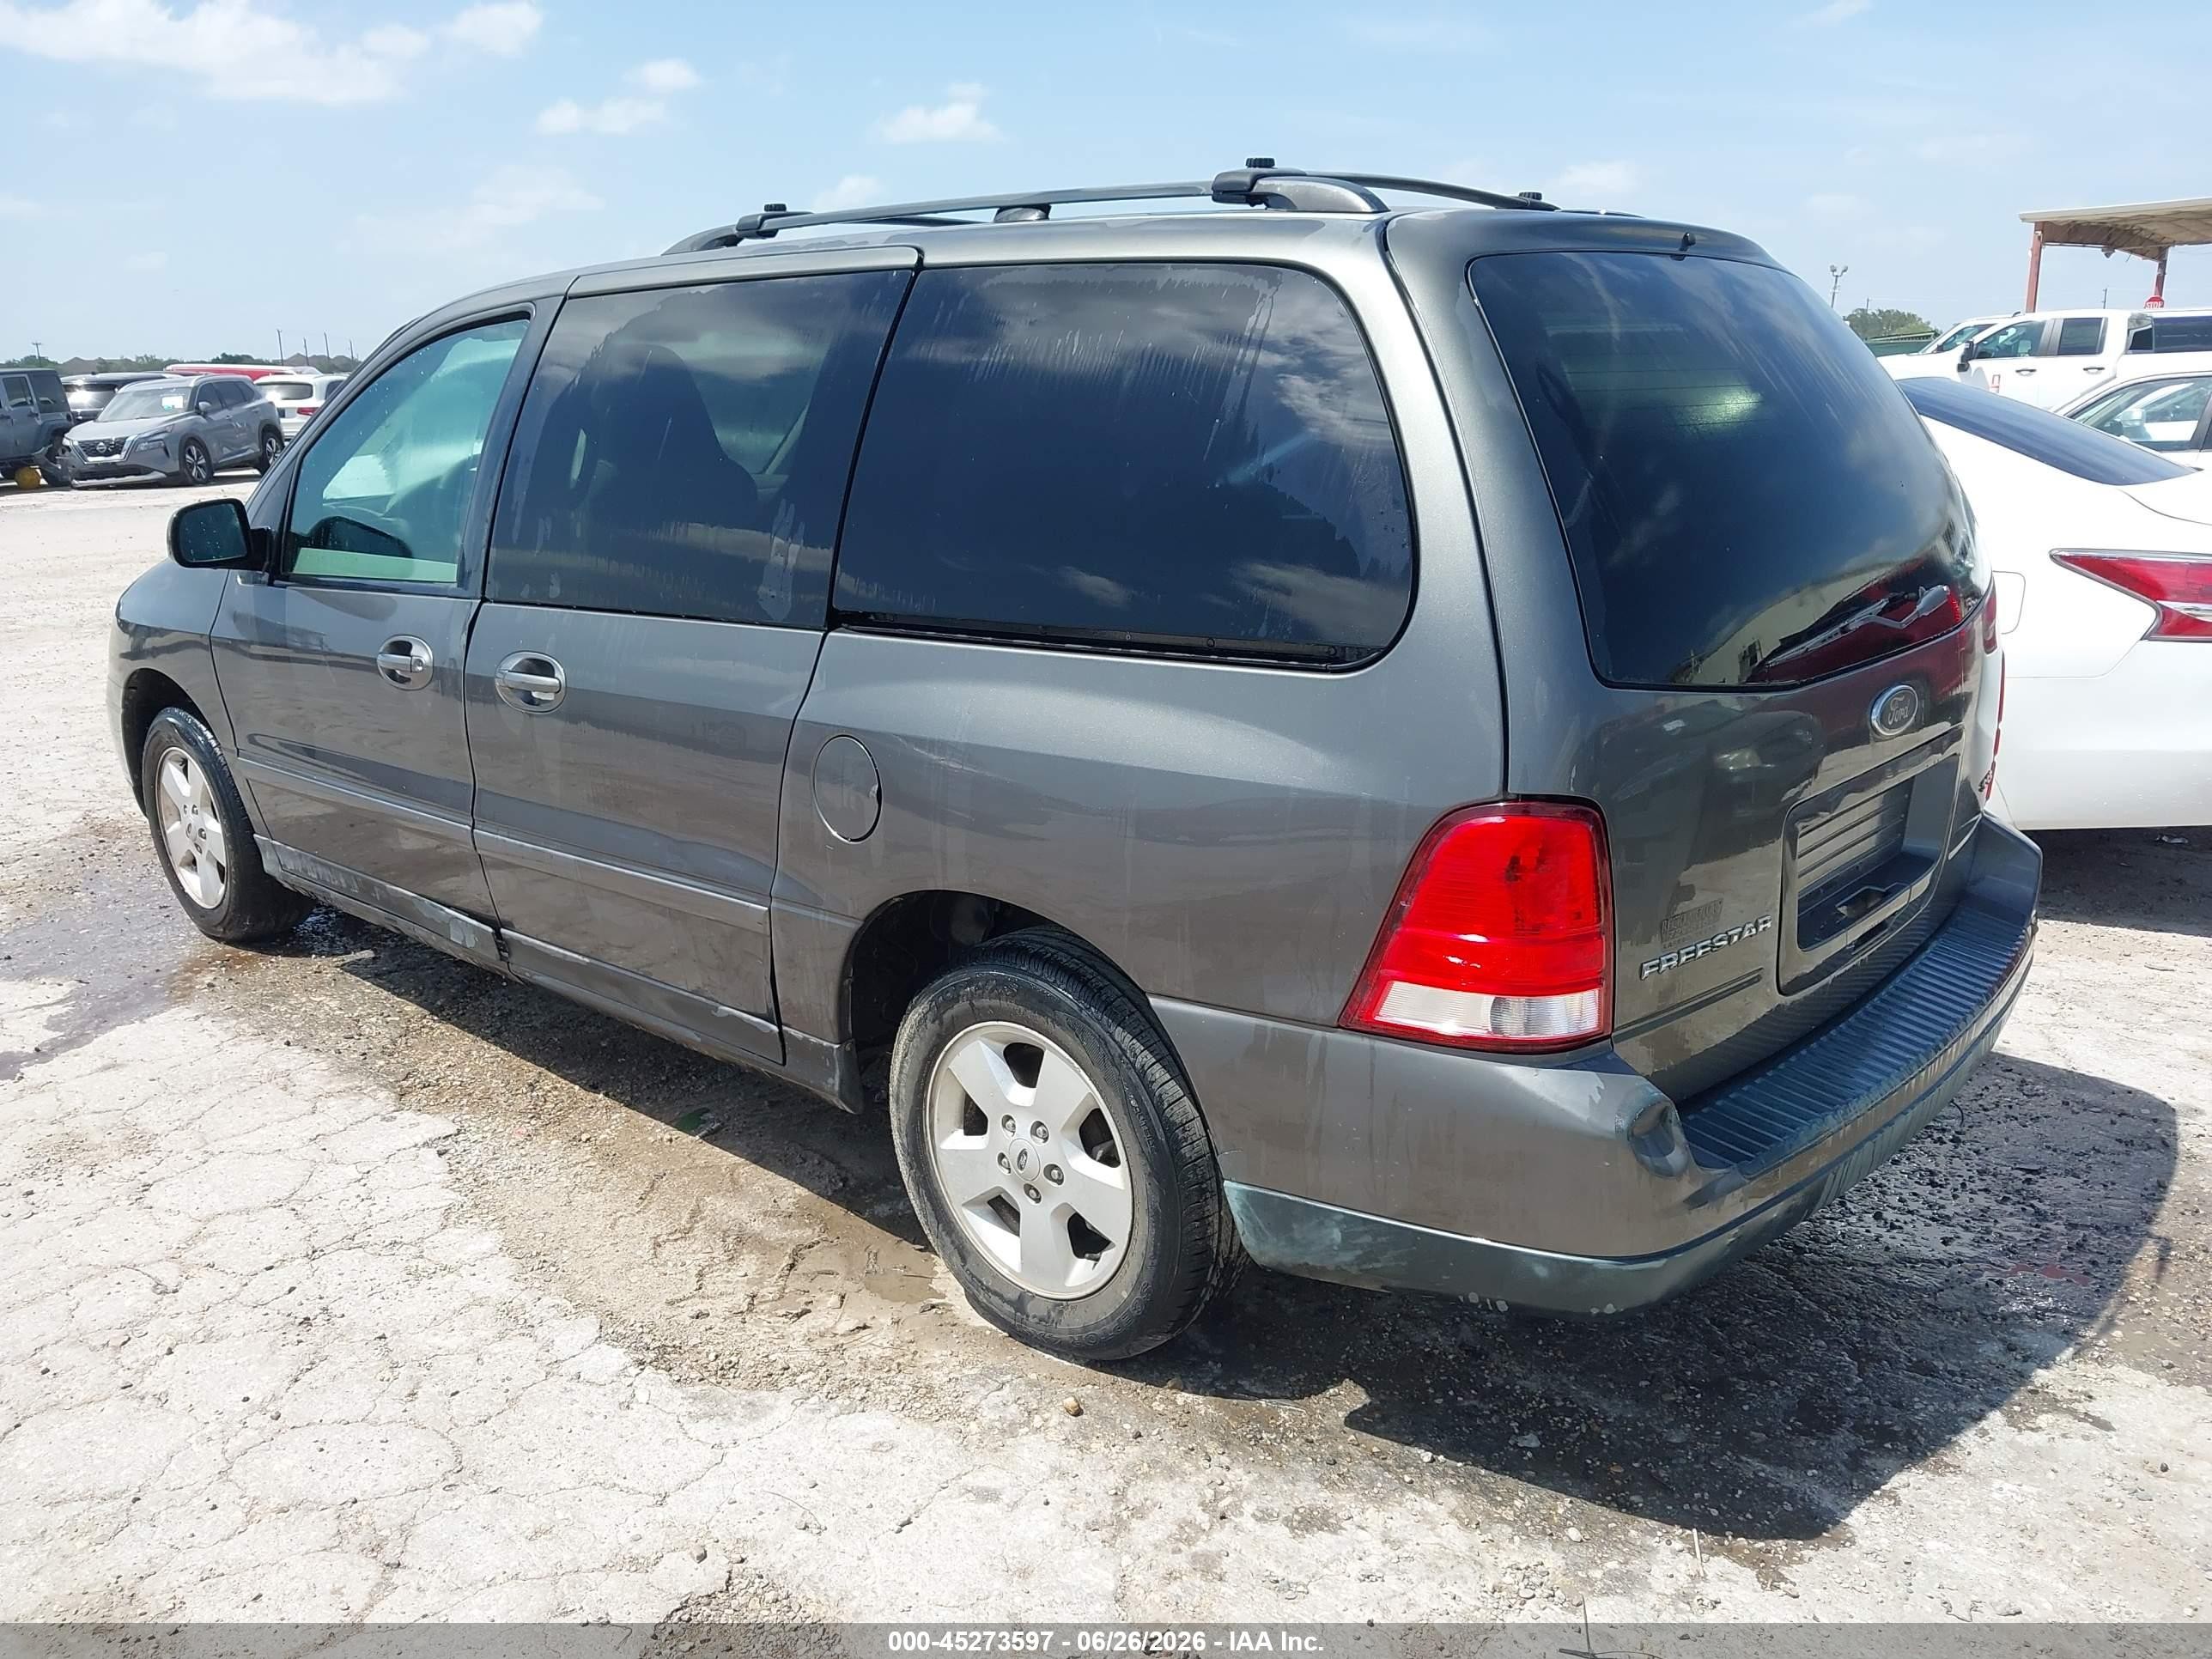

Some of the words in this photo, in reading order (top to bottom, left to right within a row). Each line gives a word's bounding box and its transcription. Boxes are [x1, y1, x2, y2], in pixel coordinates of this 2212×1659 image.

[2146, 301, 2164, 309] STOP
[1887, 696, 1910, 726] Ford
[1639, 915, 1772, 981] FREESTAR
